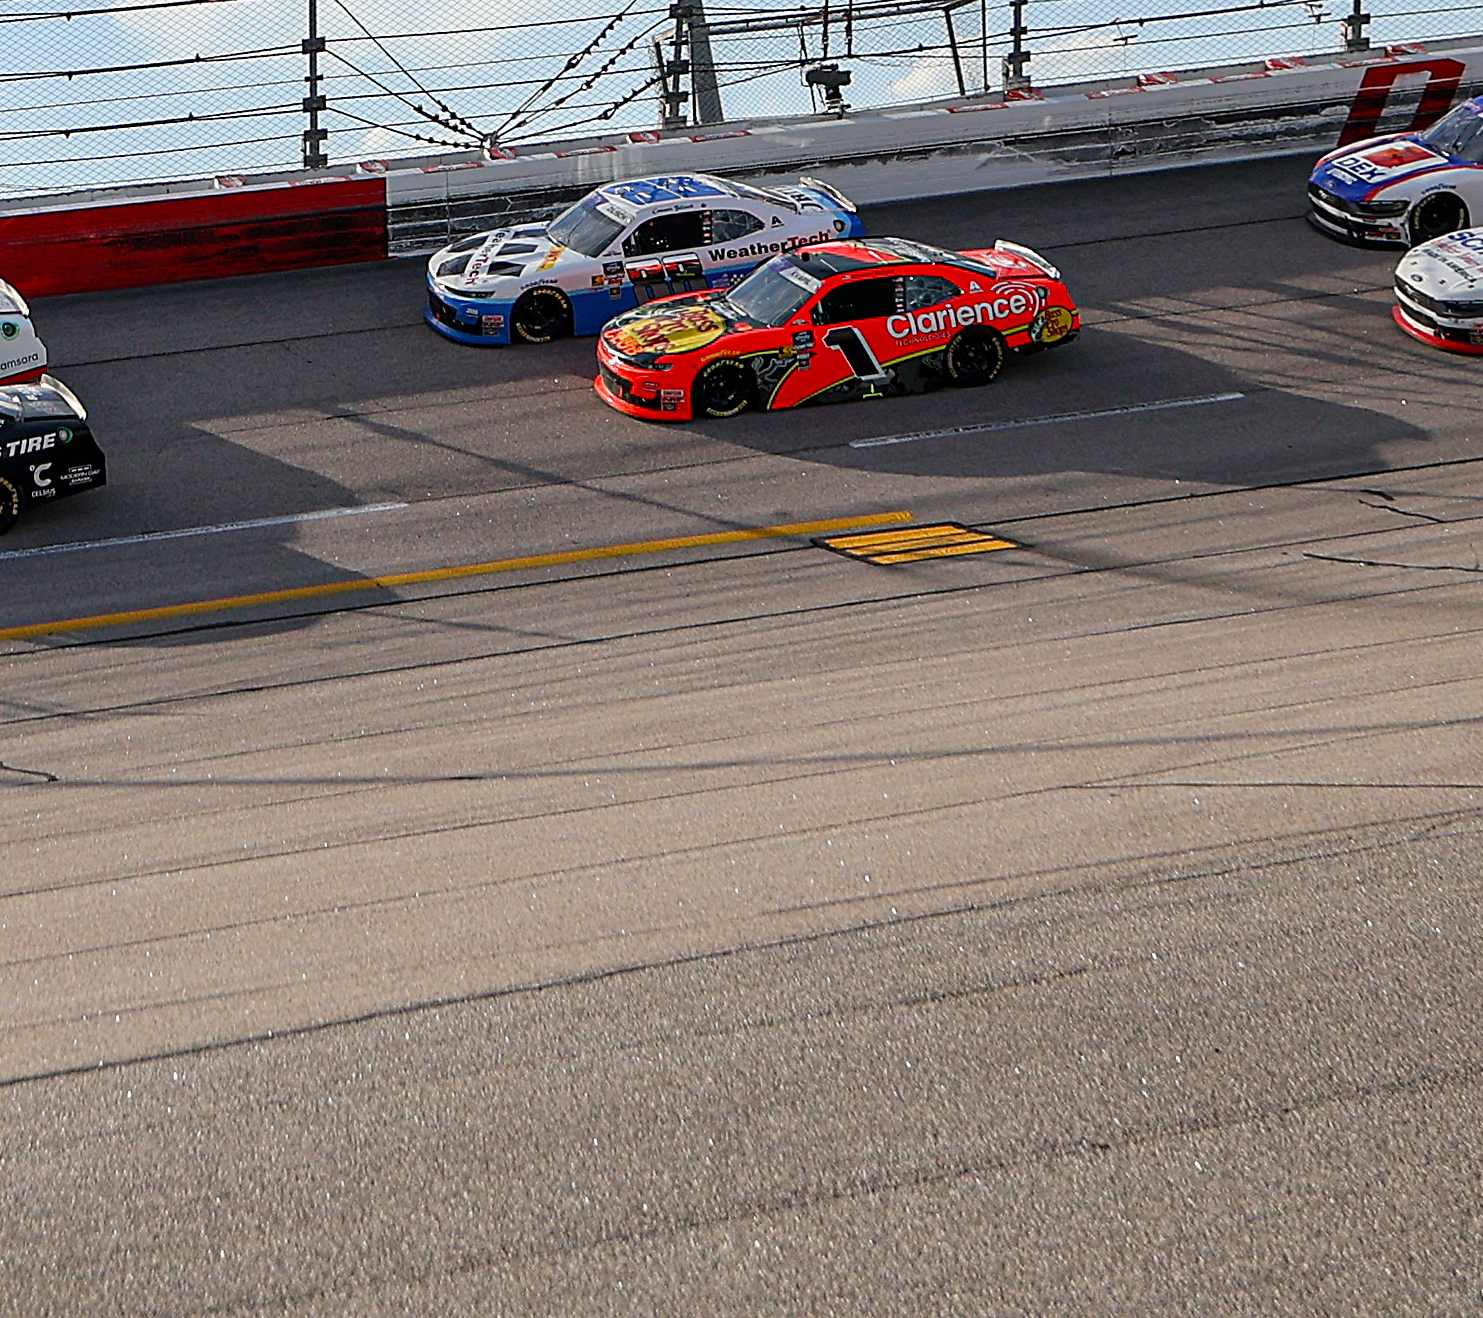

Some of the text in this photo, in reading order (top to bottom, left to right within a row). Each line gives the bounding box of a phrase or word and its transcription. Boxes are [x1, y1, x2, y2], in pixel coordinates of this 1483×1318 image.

[1336, 156, 1385, 182] DEX
[708, 230, 830, 262] WeatherTech
[886, 293, 1027, 340] Clarience
[821, 324, 887, 383] 1
[5, 431, 57, 459] TIRE
